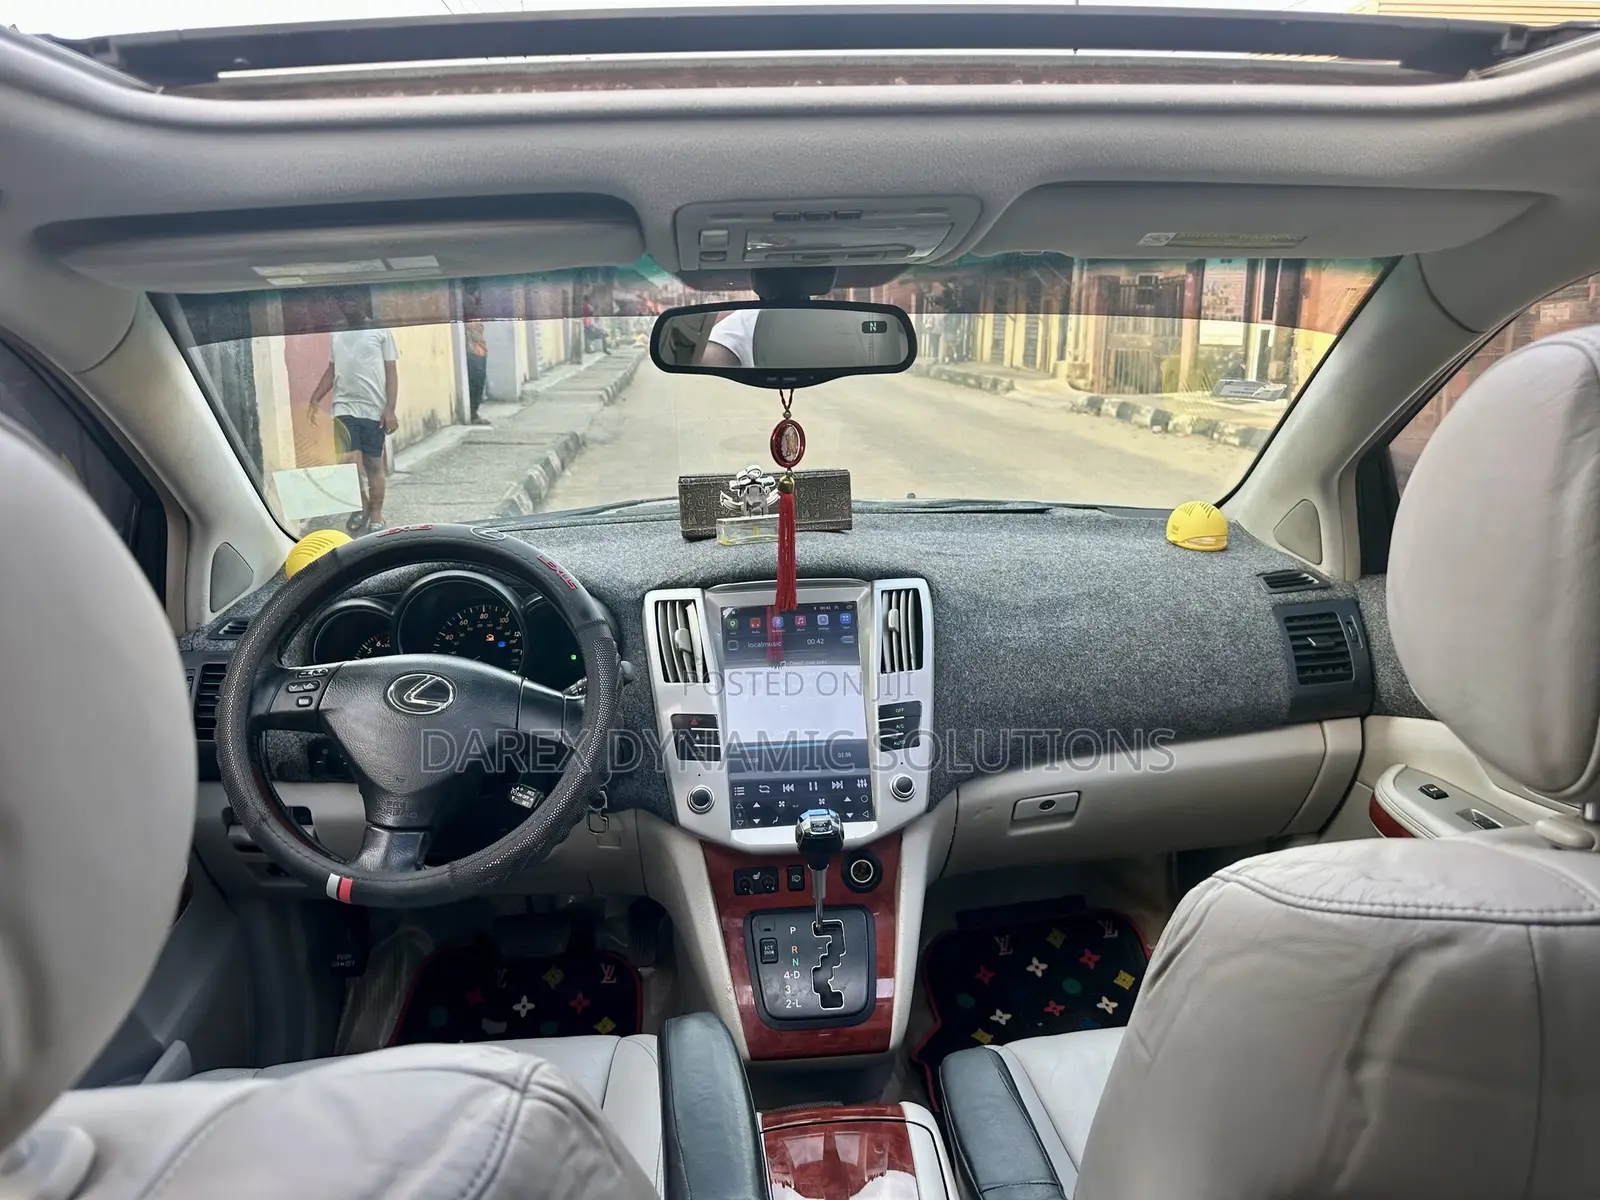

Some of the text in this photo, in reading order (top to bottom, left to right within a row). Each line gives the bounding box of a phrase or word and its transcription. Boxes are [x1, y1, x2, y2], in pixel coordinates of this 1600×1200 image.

[869, 321, 877, 332] N
[536, 552, 578, 591] LEXUS
[499, 616, 510, 624] 100
[747, 640, 782, 648] localmusic
[789, 926, 797, 935] P
[791, 946, 799, 954] R
[792, 958, 800, 967] N
[785, 985, 792, 994] 3
[785, 999, 802, 1009] 2-L
